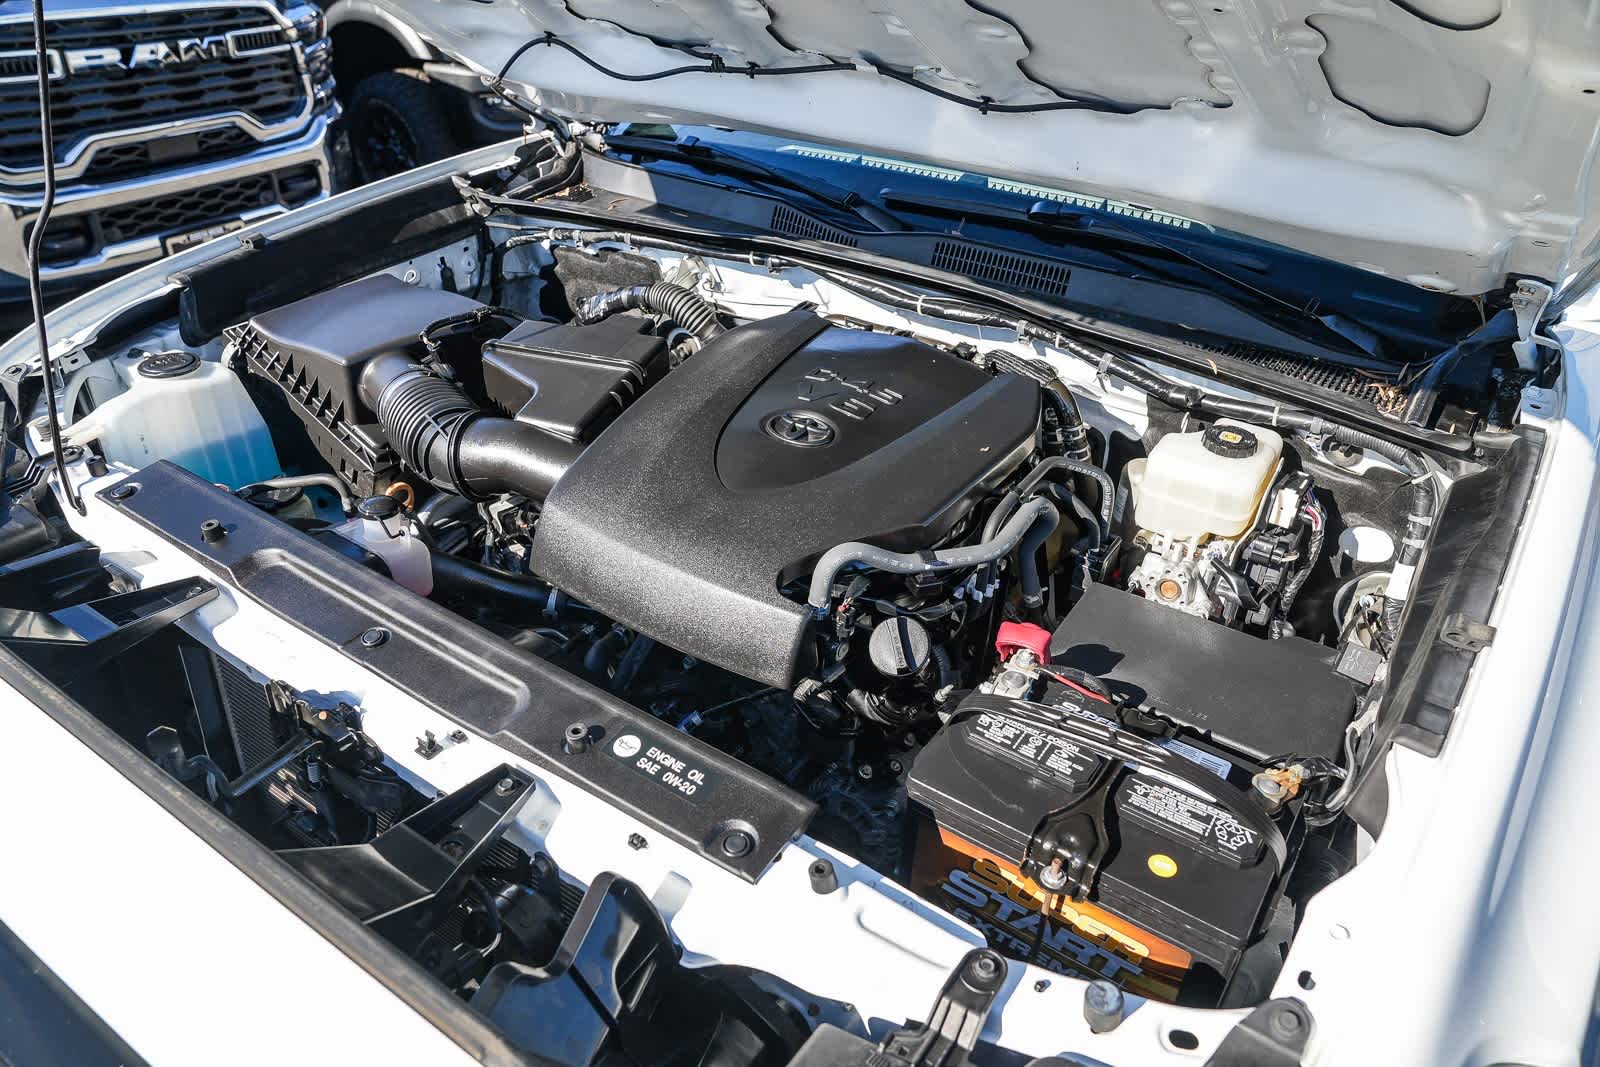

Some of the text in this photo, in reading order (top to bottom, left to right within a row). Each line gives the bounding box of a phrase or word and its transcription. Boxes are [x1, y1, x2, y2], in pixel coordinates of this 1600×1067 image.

[66, 35, 227, 75] RAM
[636, 757, 697, 796] SAE 0W-20
[646, 746, 705, 786] ENGINE OIL
[942, 869, 1143, 978] START
[968, 858, 1151, 965] SUPER
[952, 907, 1090, 980] EXTREM
